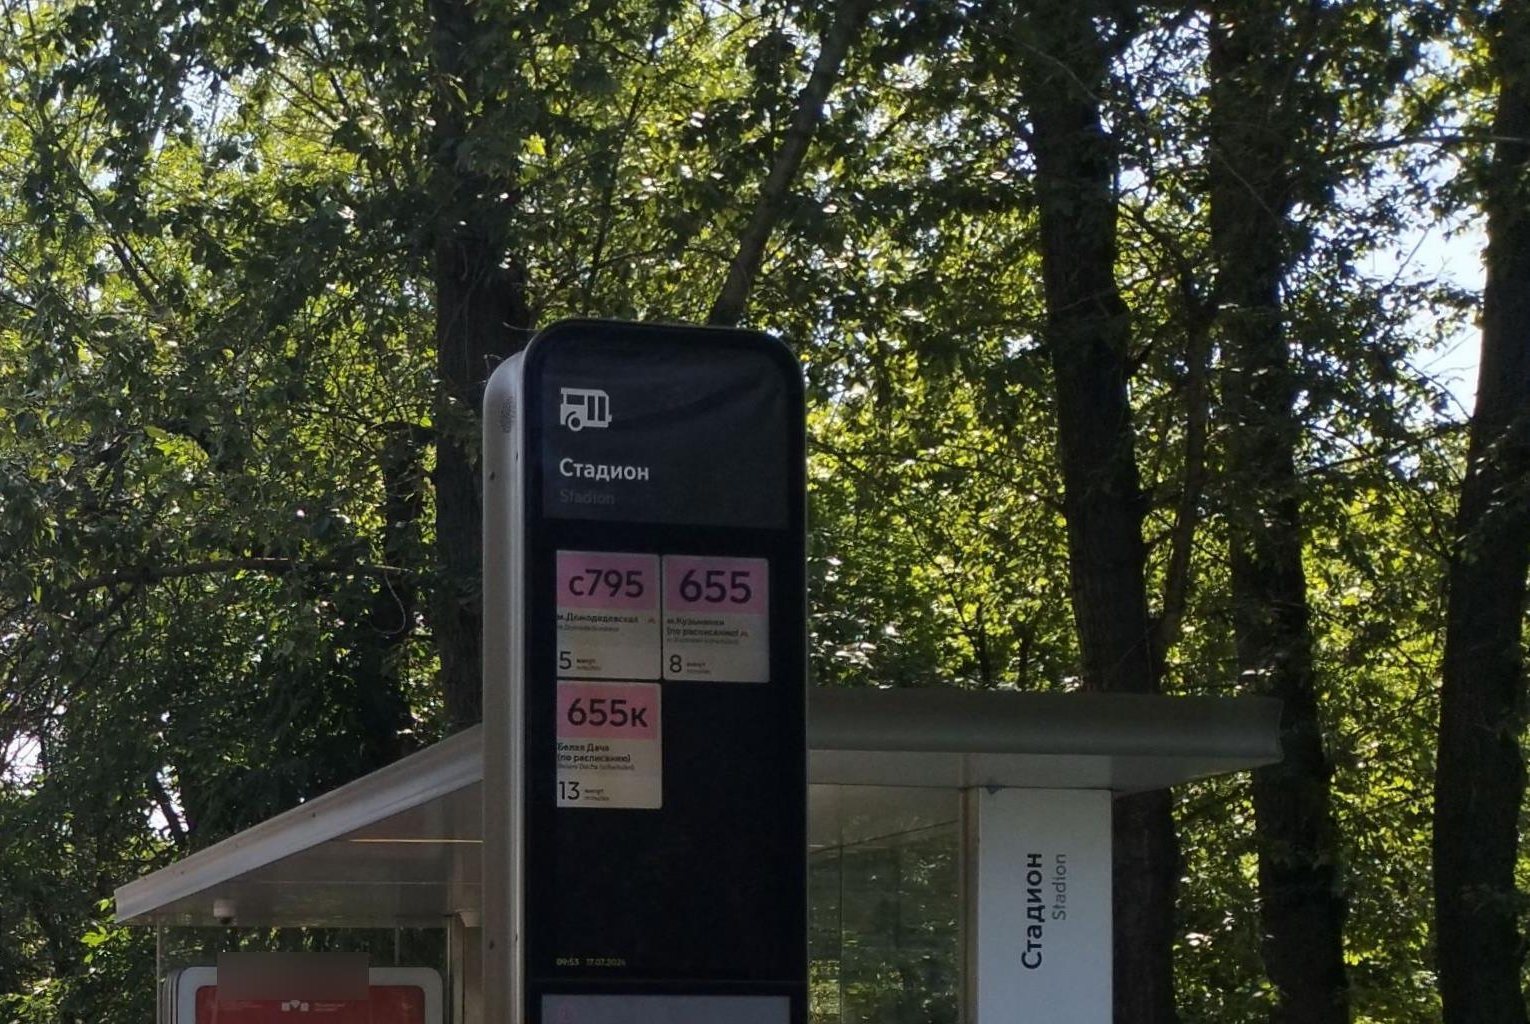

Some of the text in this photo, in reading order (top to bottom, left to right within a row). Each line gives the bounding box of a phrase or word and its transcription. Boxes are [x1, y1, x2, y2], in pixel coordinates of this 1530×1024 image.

[559, 457, 650, 482] Стадион
[679, 568, 752, 604] 655
[558, 650, 572, 670] 5
[669, 654, 683, 673] 8
[558, 780, 581, 801] 13
[1051, 853, 1067, 921] Stadion
[1021, 852, 1046, 970] Стадион
